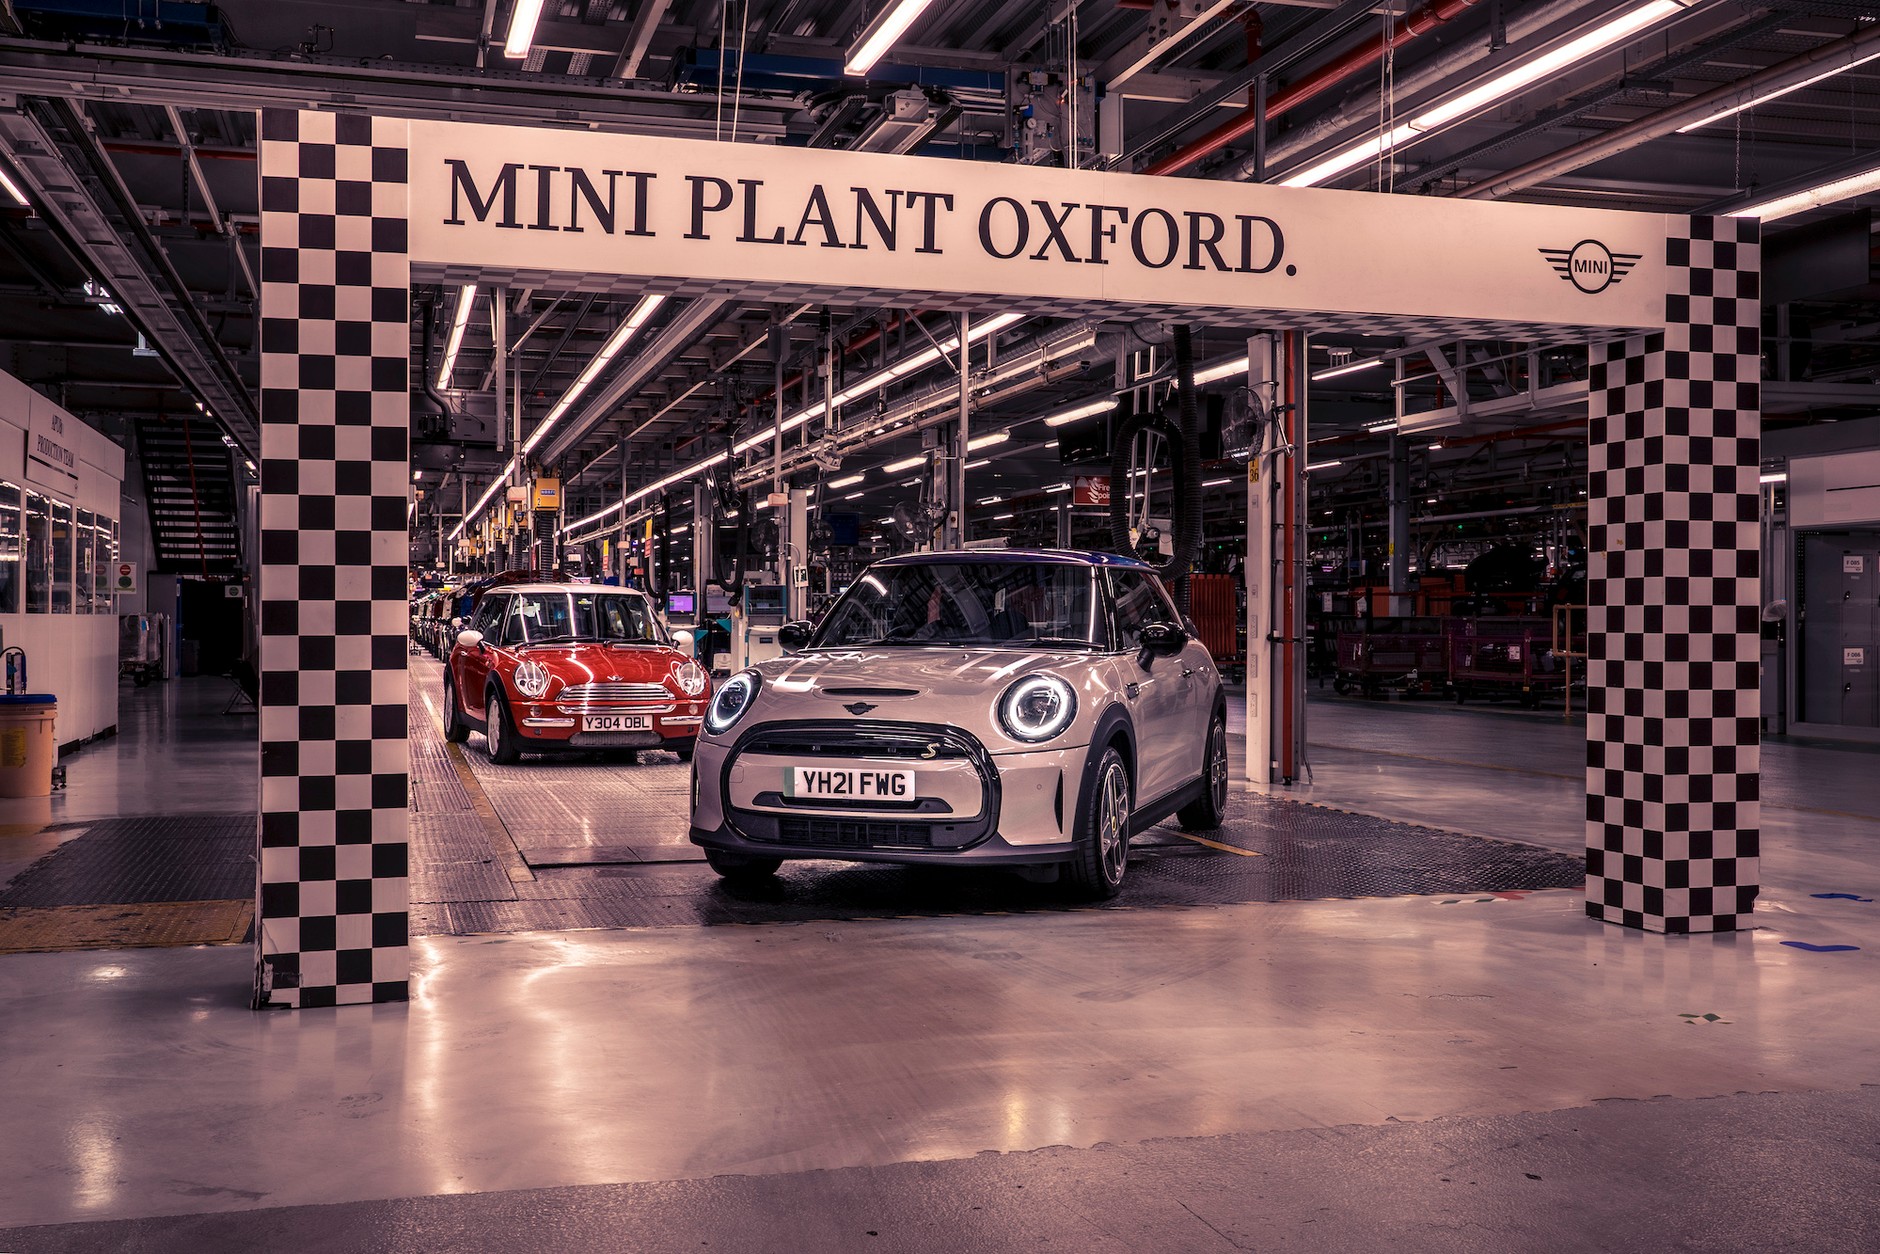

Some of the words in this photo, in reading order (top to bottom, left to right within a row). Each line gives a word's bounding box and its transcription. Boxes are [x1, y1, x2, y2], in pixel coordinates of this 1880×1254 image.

[443, 158, 658, 237] MINI
[683, 175, 954, 254] PLANT
[978, 196, 1298, 277] OXFORD.
[1574, 259, 1608, 274] MINI
[1098, 492, 1110, 500] poi
[585, 717, 621, 729] Y304
[624, 716, 650, 729] OBL
[803, 771, 853, 795] YH21
[860, 772, 906, 796] FWG
